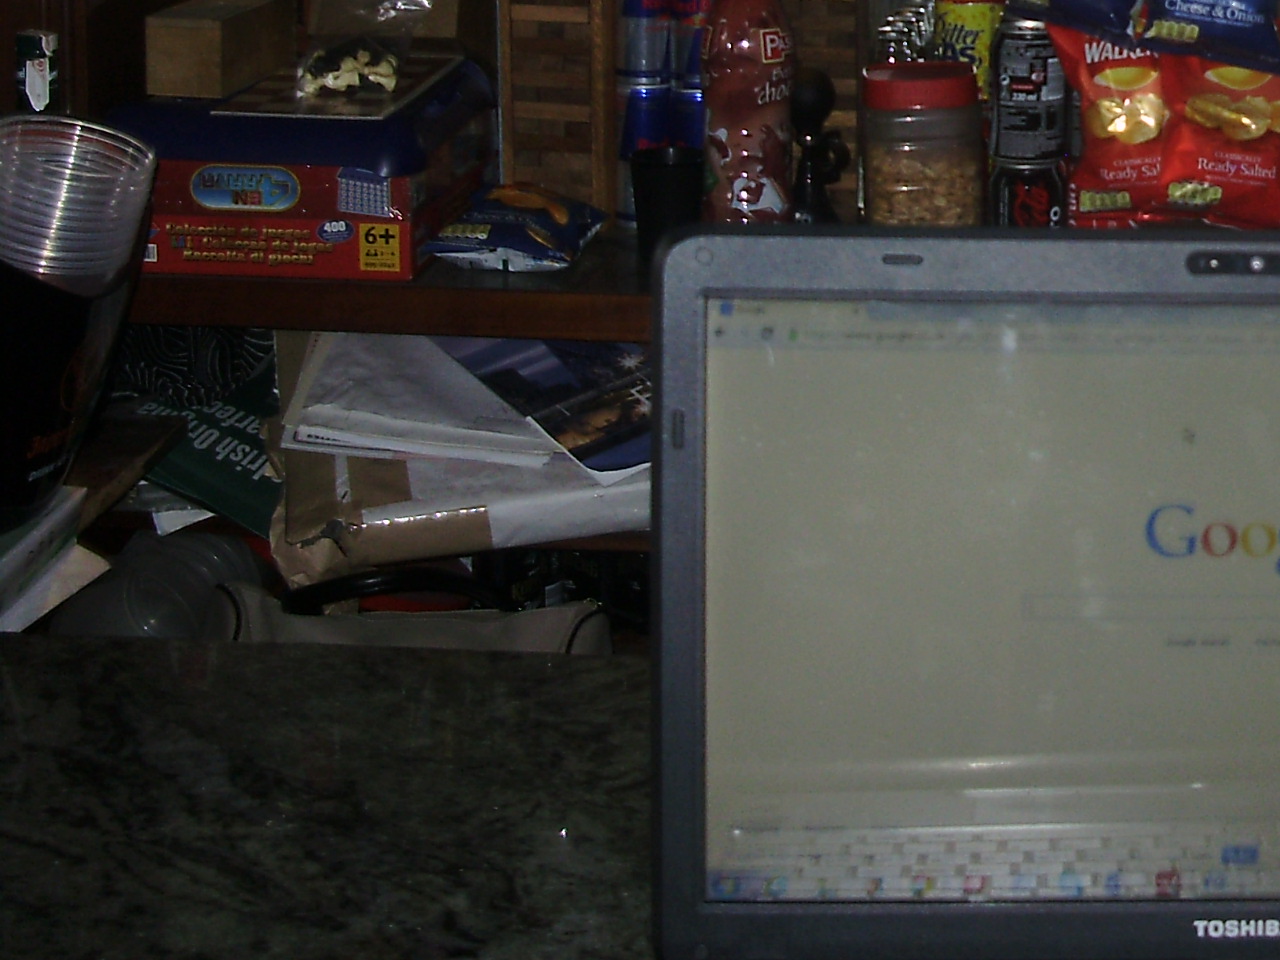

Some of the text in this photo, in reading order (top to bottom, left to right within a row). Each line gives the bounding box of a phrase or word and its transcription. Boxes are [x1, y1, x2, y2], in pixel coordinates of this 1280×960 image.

[1226, 8, 1265, 25] Onion
[1198, 158, 1277, 180] Ready Salted
[364, 226, 396, 245] 6+
